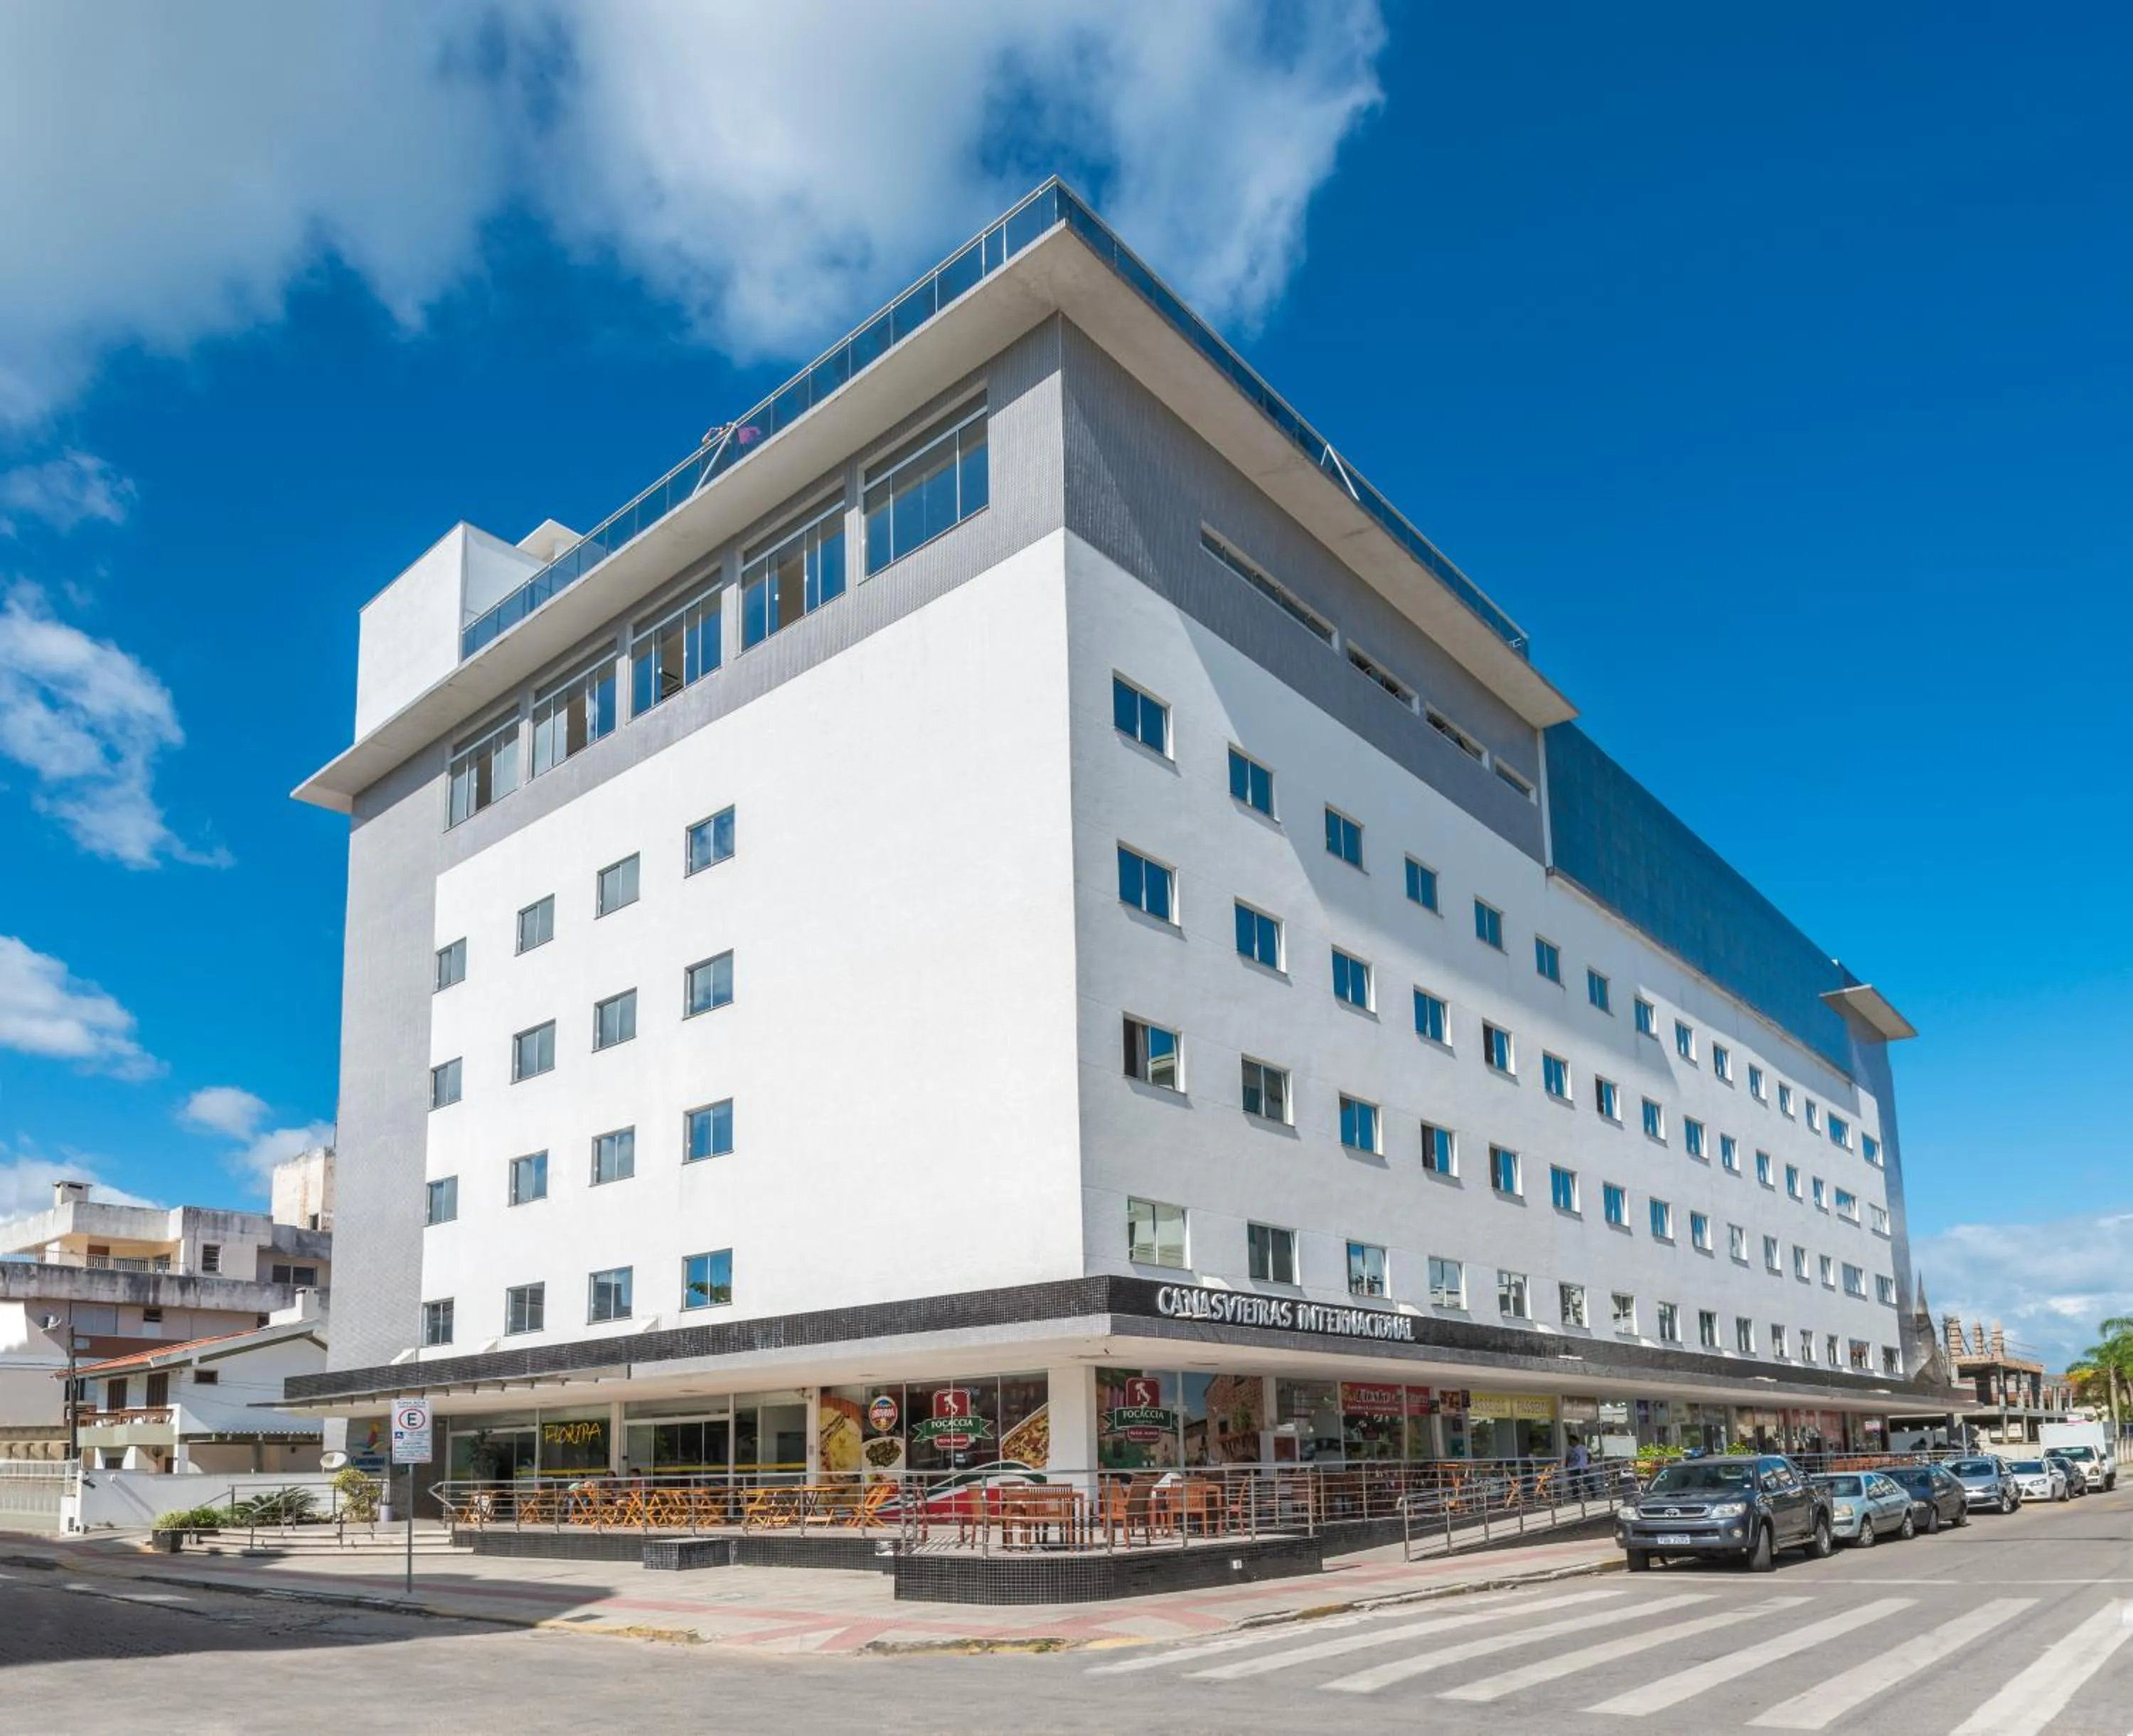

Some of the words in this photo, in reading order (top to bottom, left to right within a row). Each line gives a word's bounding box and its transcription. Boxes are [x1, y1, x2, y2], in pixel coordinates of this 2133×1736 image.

[1158, 1286, 1292, 1327] CANASVIEIRAS
[1297, 1304, 1415, 1340] INTERNACIONAL
[407, 1413, 417, 1426] E
[1123, 1410, 1164, 1419] FOCACCIA
[931, 1418, 973, 1428] FOCACCIA
